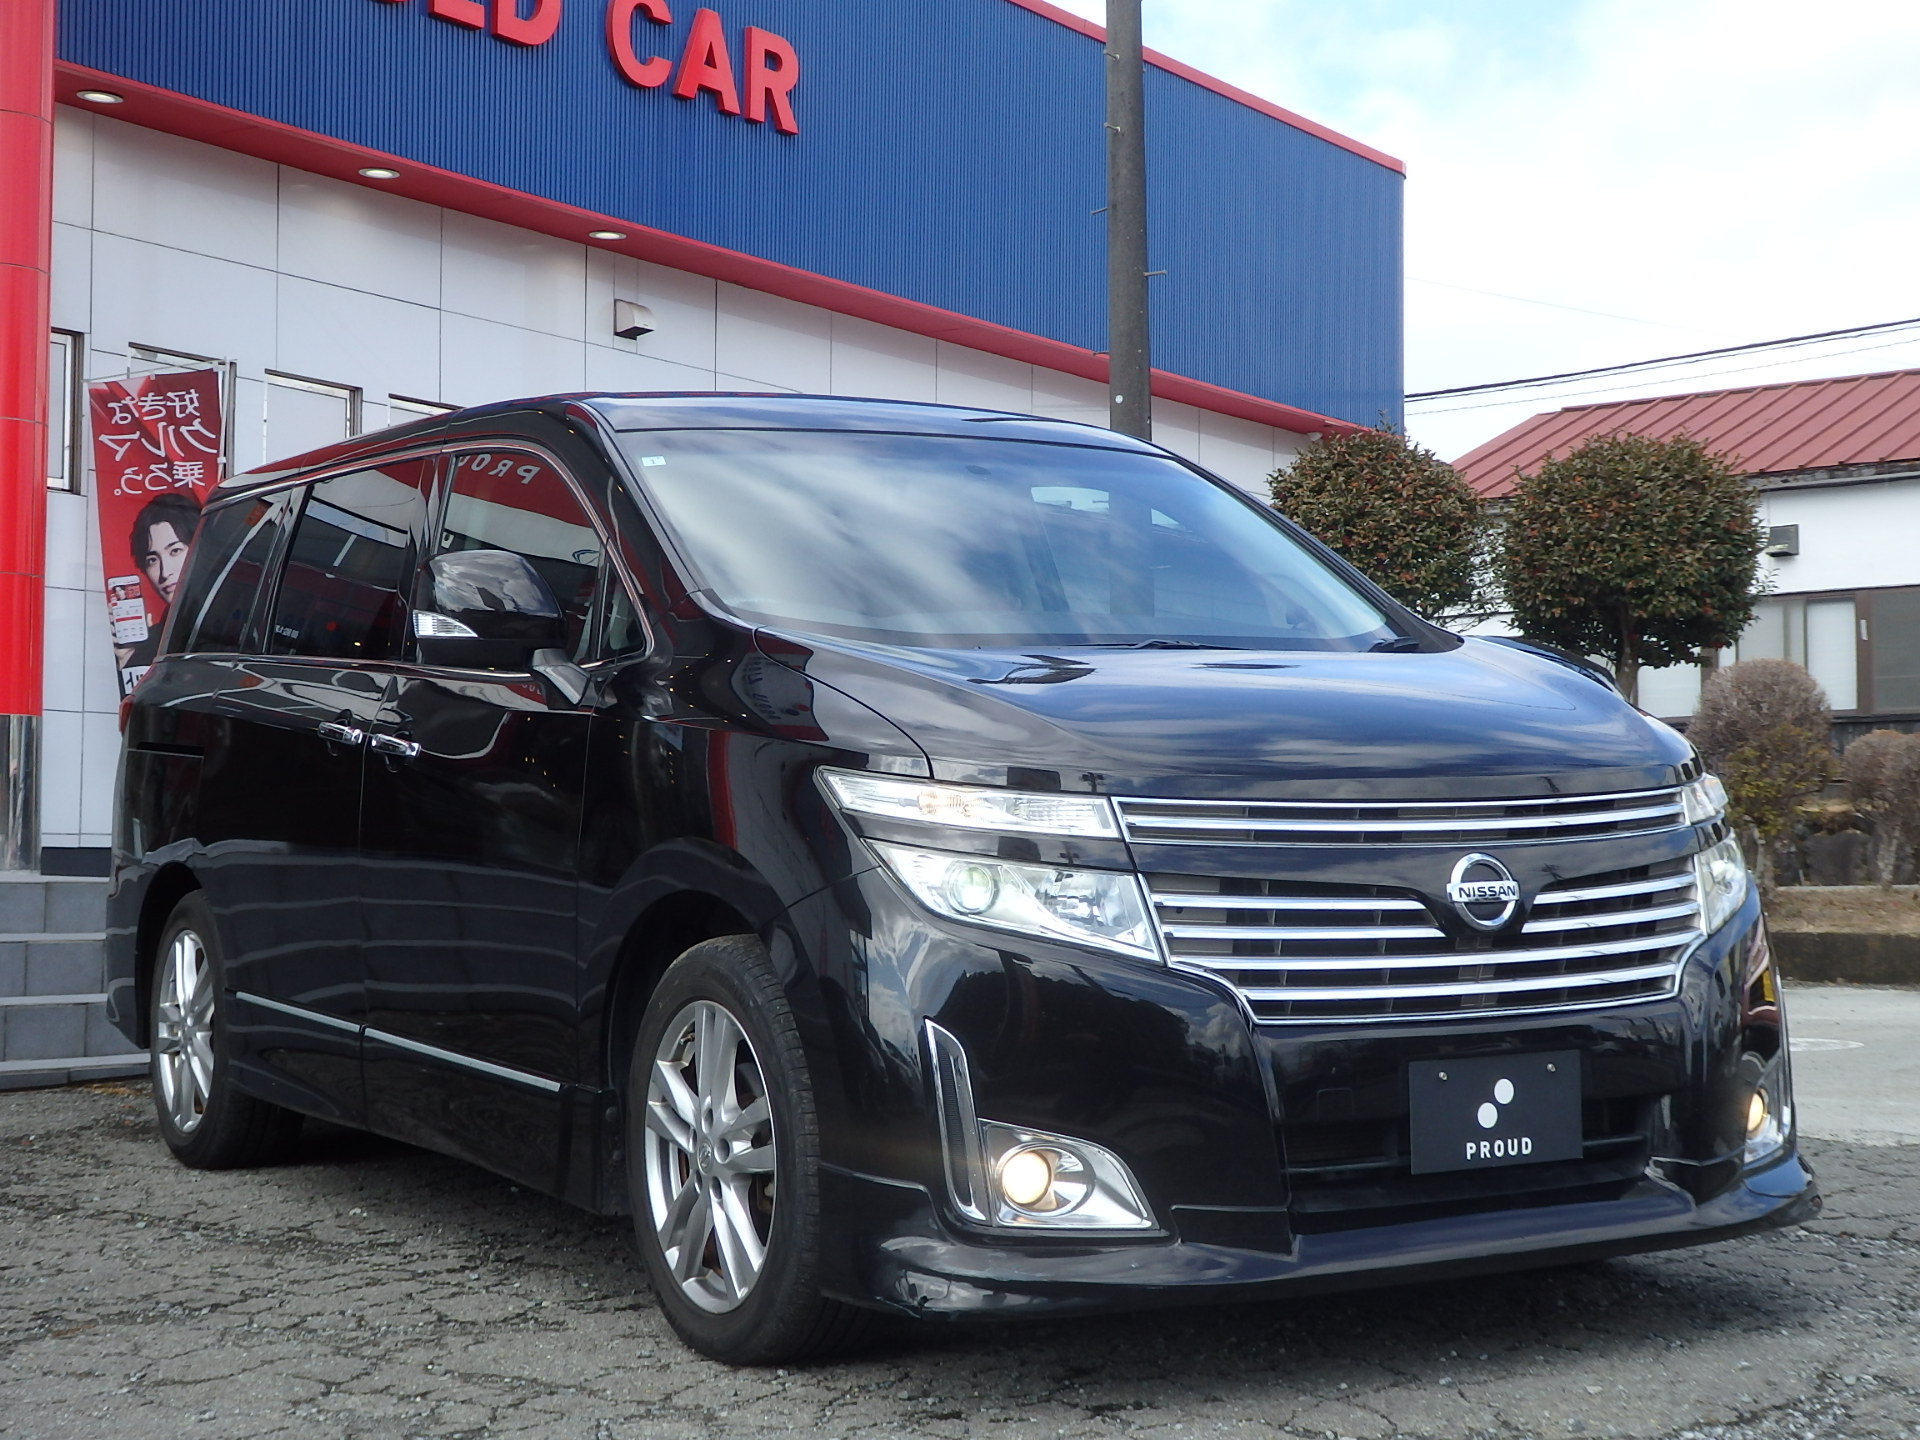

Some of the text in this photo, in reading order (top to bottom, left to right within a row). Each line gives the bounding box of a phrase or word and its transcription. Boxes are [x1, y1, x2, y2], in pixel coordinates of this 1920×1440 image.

[605, 0, 799, 135] CAR
[1458, 881, 1516, 898] NISSAN
[1466, 1136, 1532, 1160] PROUD
